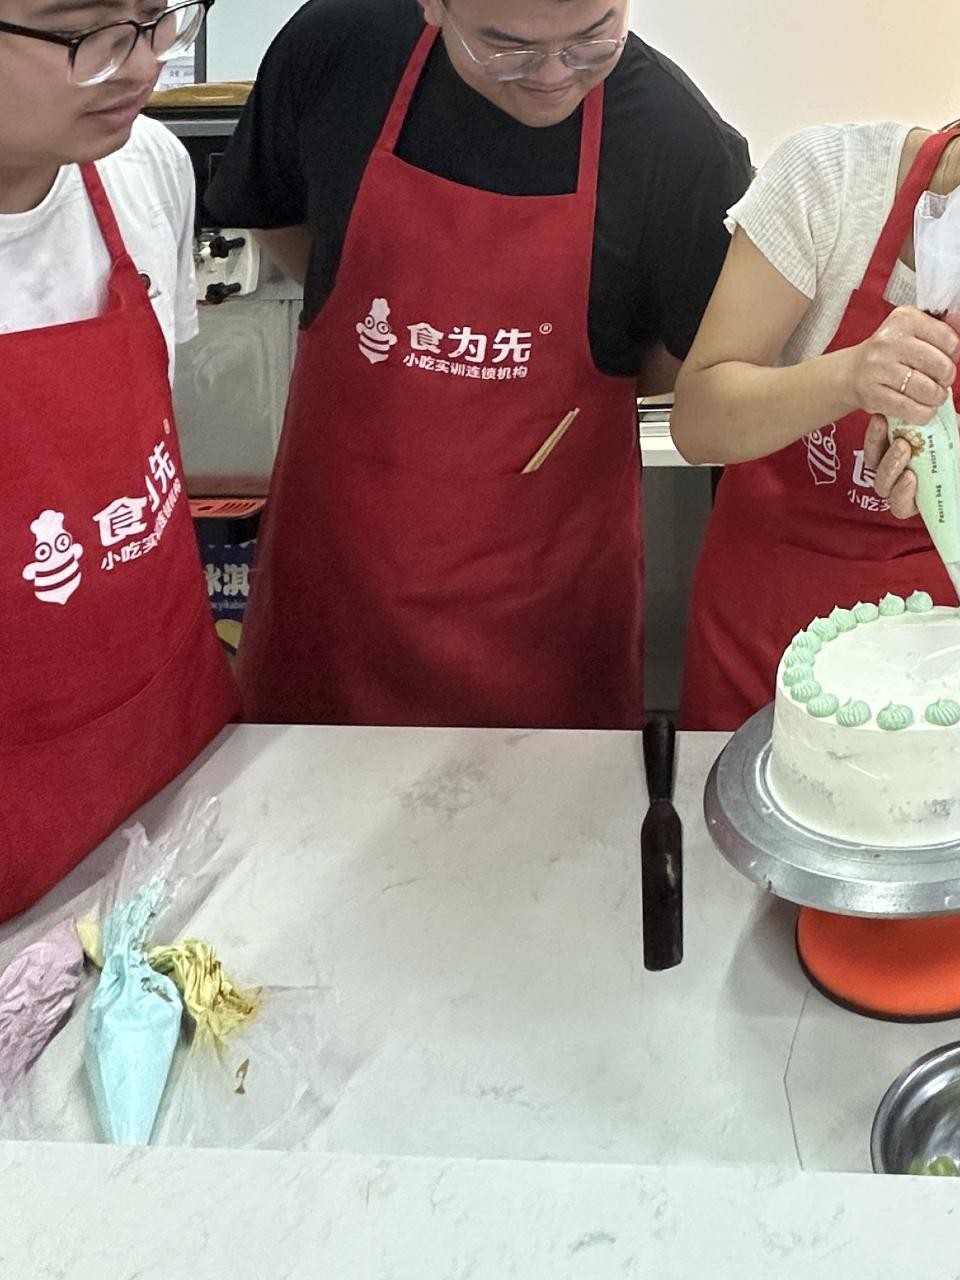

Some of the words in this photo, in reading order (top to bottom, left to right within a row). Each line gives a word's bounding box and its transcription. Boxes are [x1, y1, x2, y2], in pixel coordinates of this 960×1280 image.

[407, 322, 532, 364] 食为先
[403, 353, 528, 380] 小吃实训连锁机构
